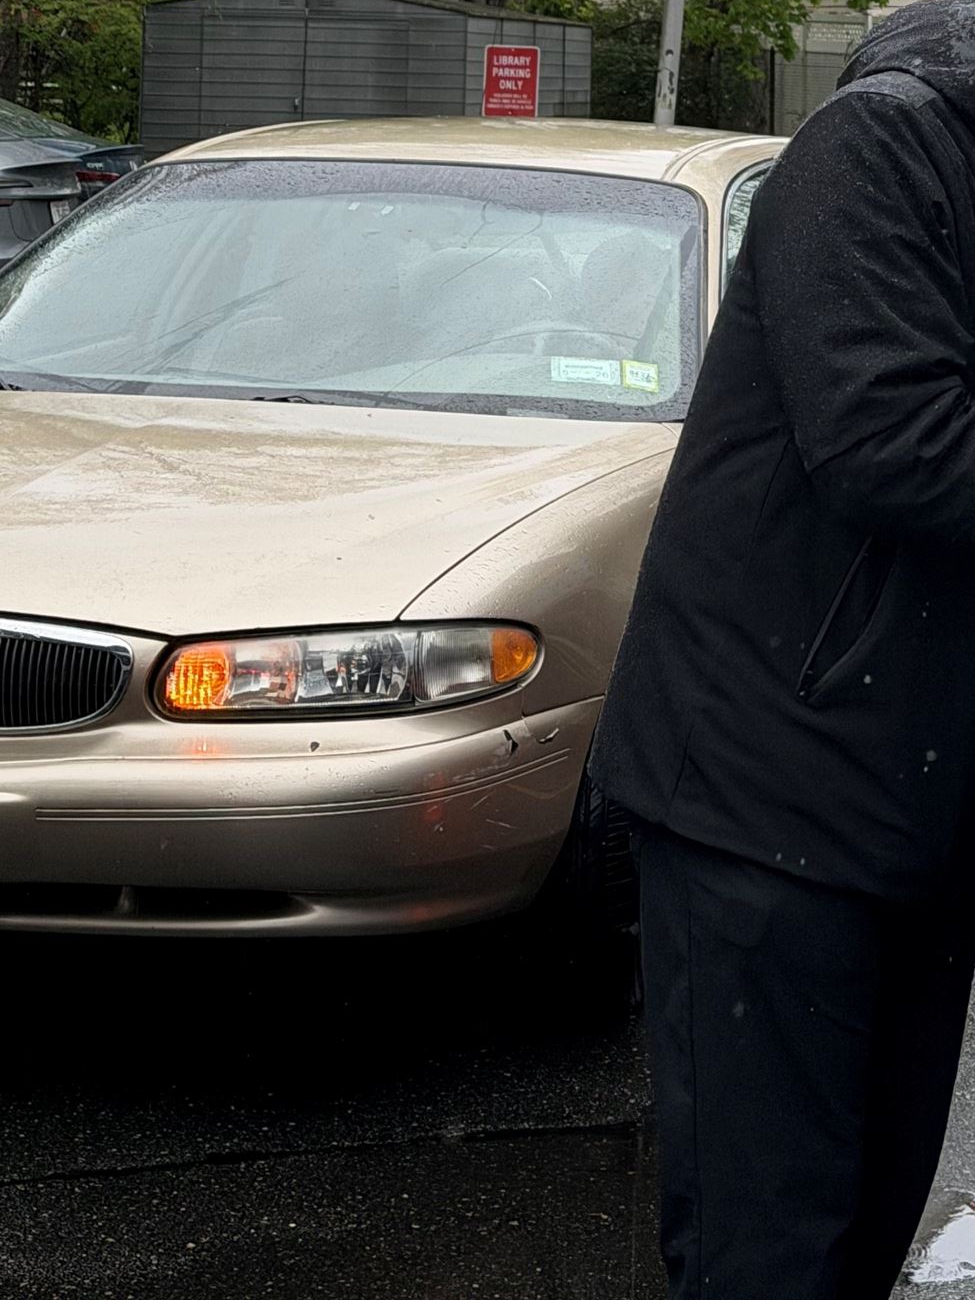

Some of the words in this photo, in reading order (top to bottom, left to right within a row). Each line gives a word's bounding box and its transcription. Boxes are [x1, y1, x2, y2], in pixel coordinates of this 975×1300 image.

[493, 55, 531, 66] LIBRARY
[492, 67, 531, 78] PARKING
[499, 79, 523, 90] ONLY
